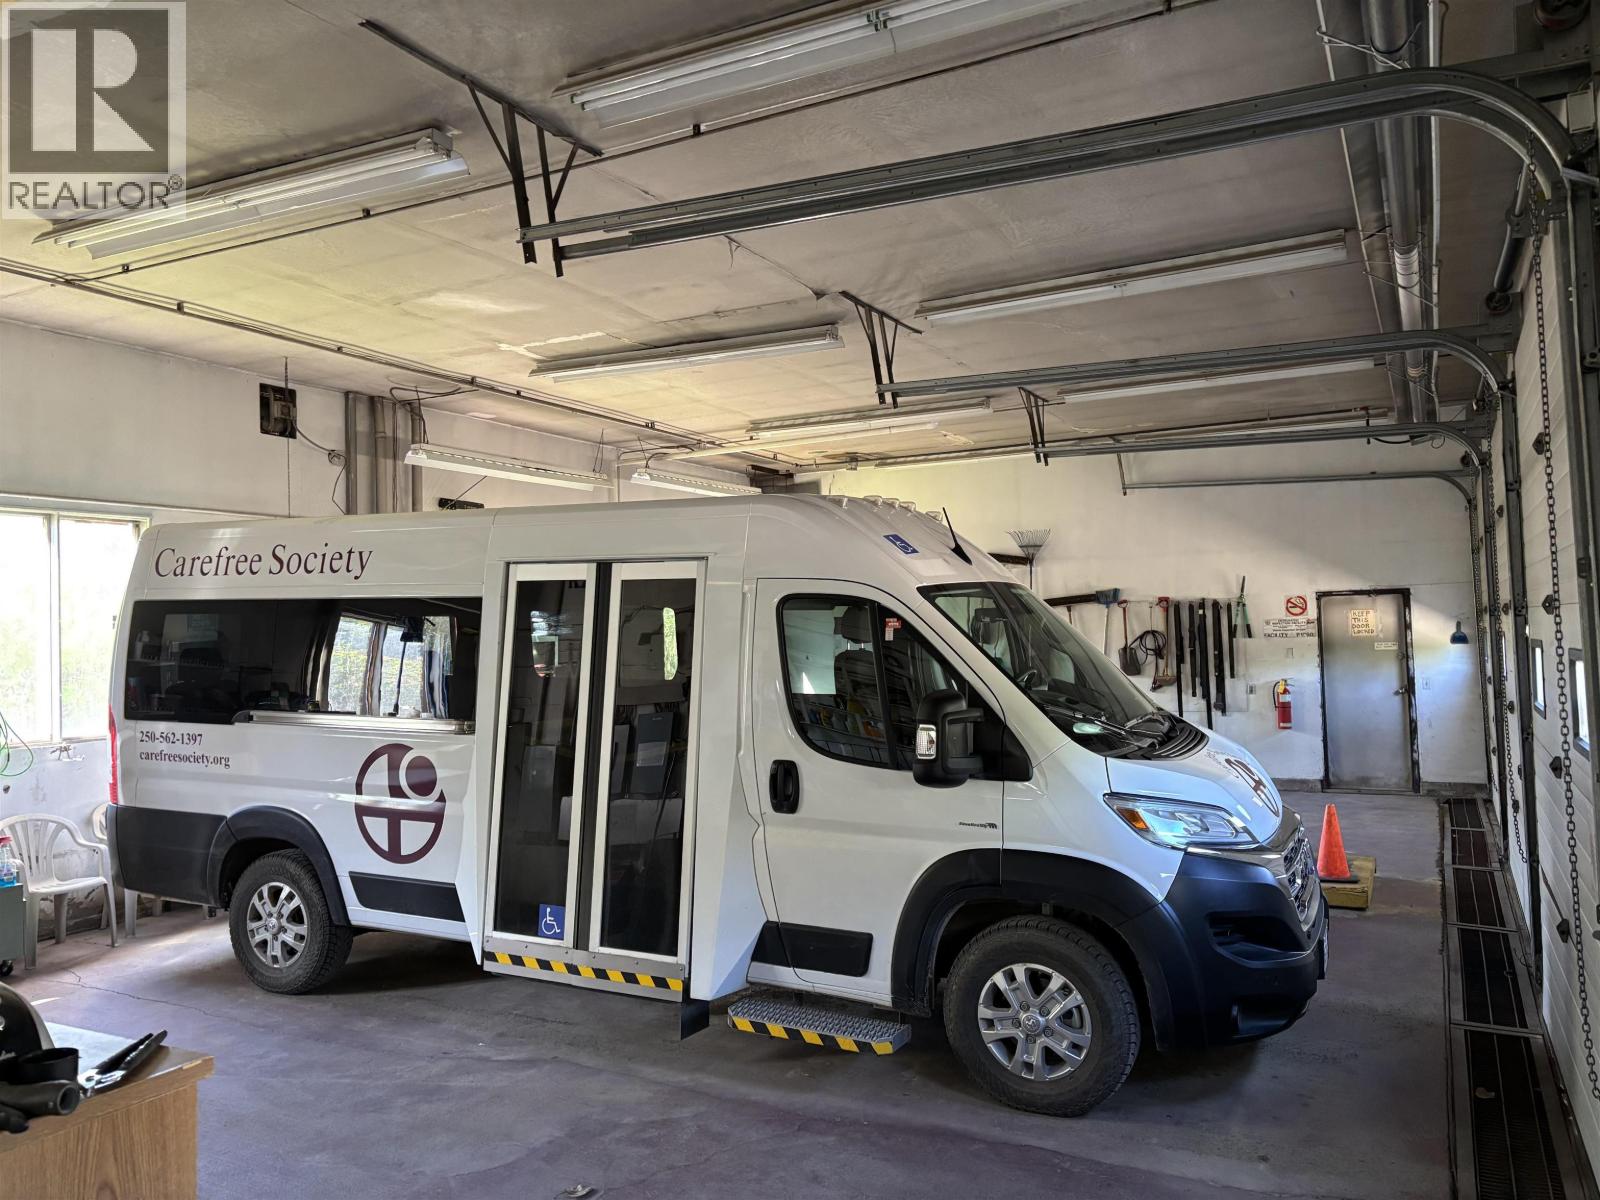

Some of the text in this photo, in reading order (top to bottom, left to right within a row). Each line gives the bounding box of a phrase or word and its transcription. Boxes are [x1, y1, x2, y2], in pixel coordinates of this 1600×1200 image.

[154, 542, 374, 580] Carefree Society
[139, 731, 203, 746] 250-562-1397
[139, 749, 230, 769] carefreesociety.org
